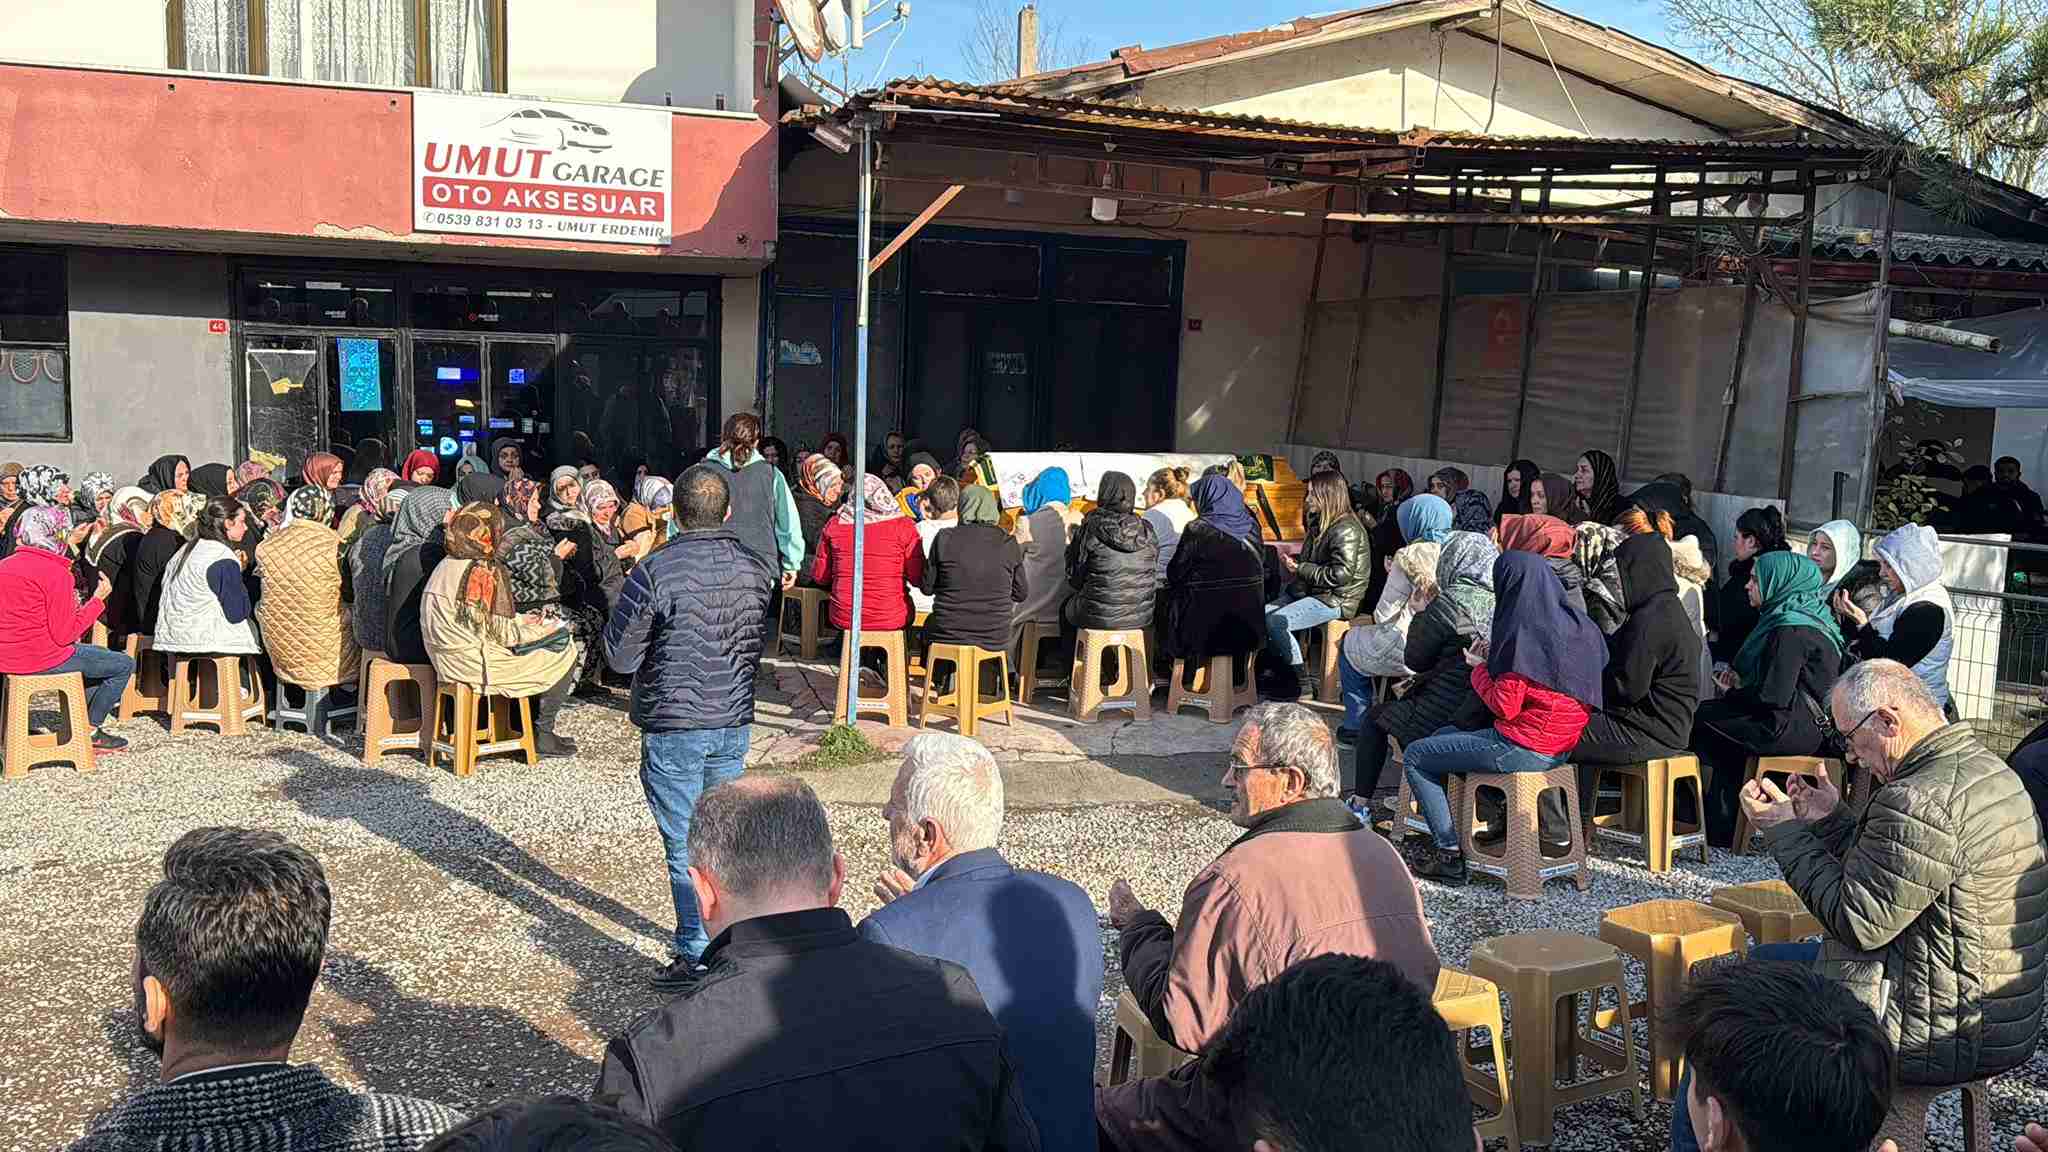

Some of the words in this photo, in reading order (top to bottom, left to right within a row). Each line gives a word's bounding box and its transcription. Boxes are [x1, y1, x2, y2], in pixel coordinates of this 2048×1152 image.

[423, 142, 552, 179] UMUT
[552, 162, 665, 188] GARAGE
[431, 183, 492, 205] OTO
[503, 187, 657, 216] AKSESUAR
[436, 212, 471, 226] 0539
[475, 214, 500, 228] 831
[505, 217, 522, 229] 03
[527, 218, 543, 230] 13
[557, 220, 597, 234] UMUT
